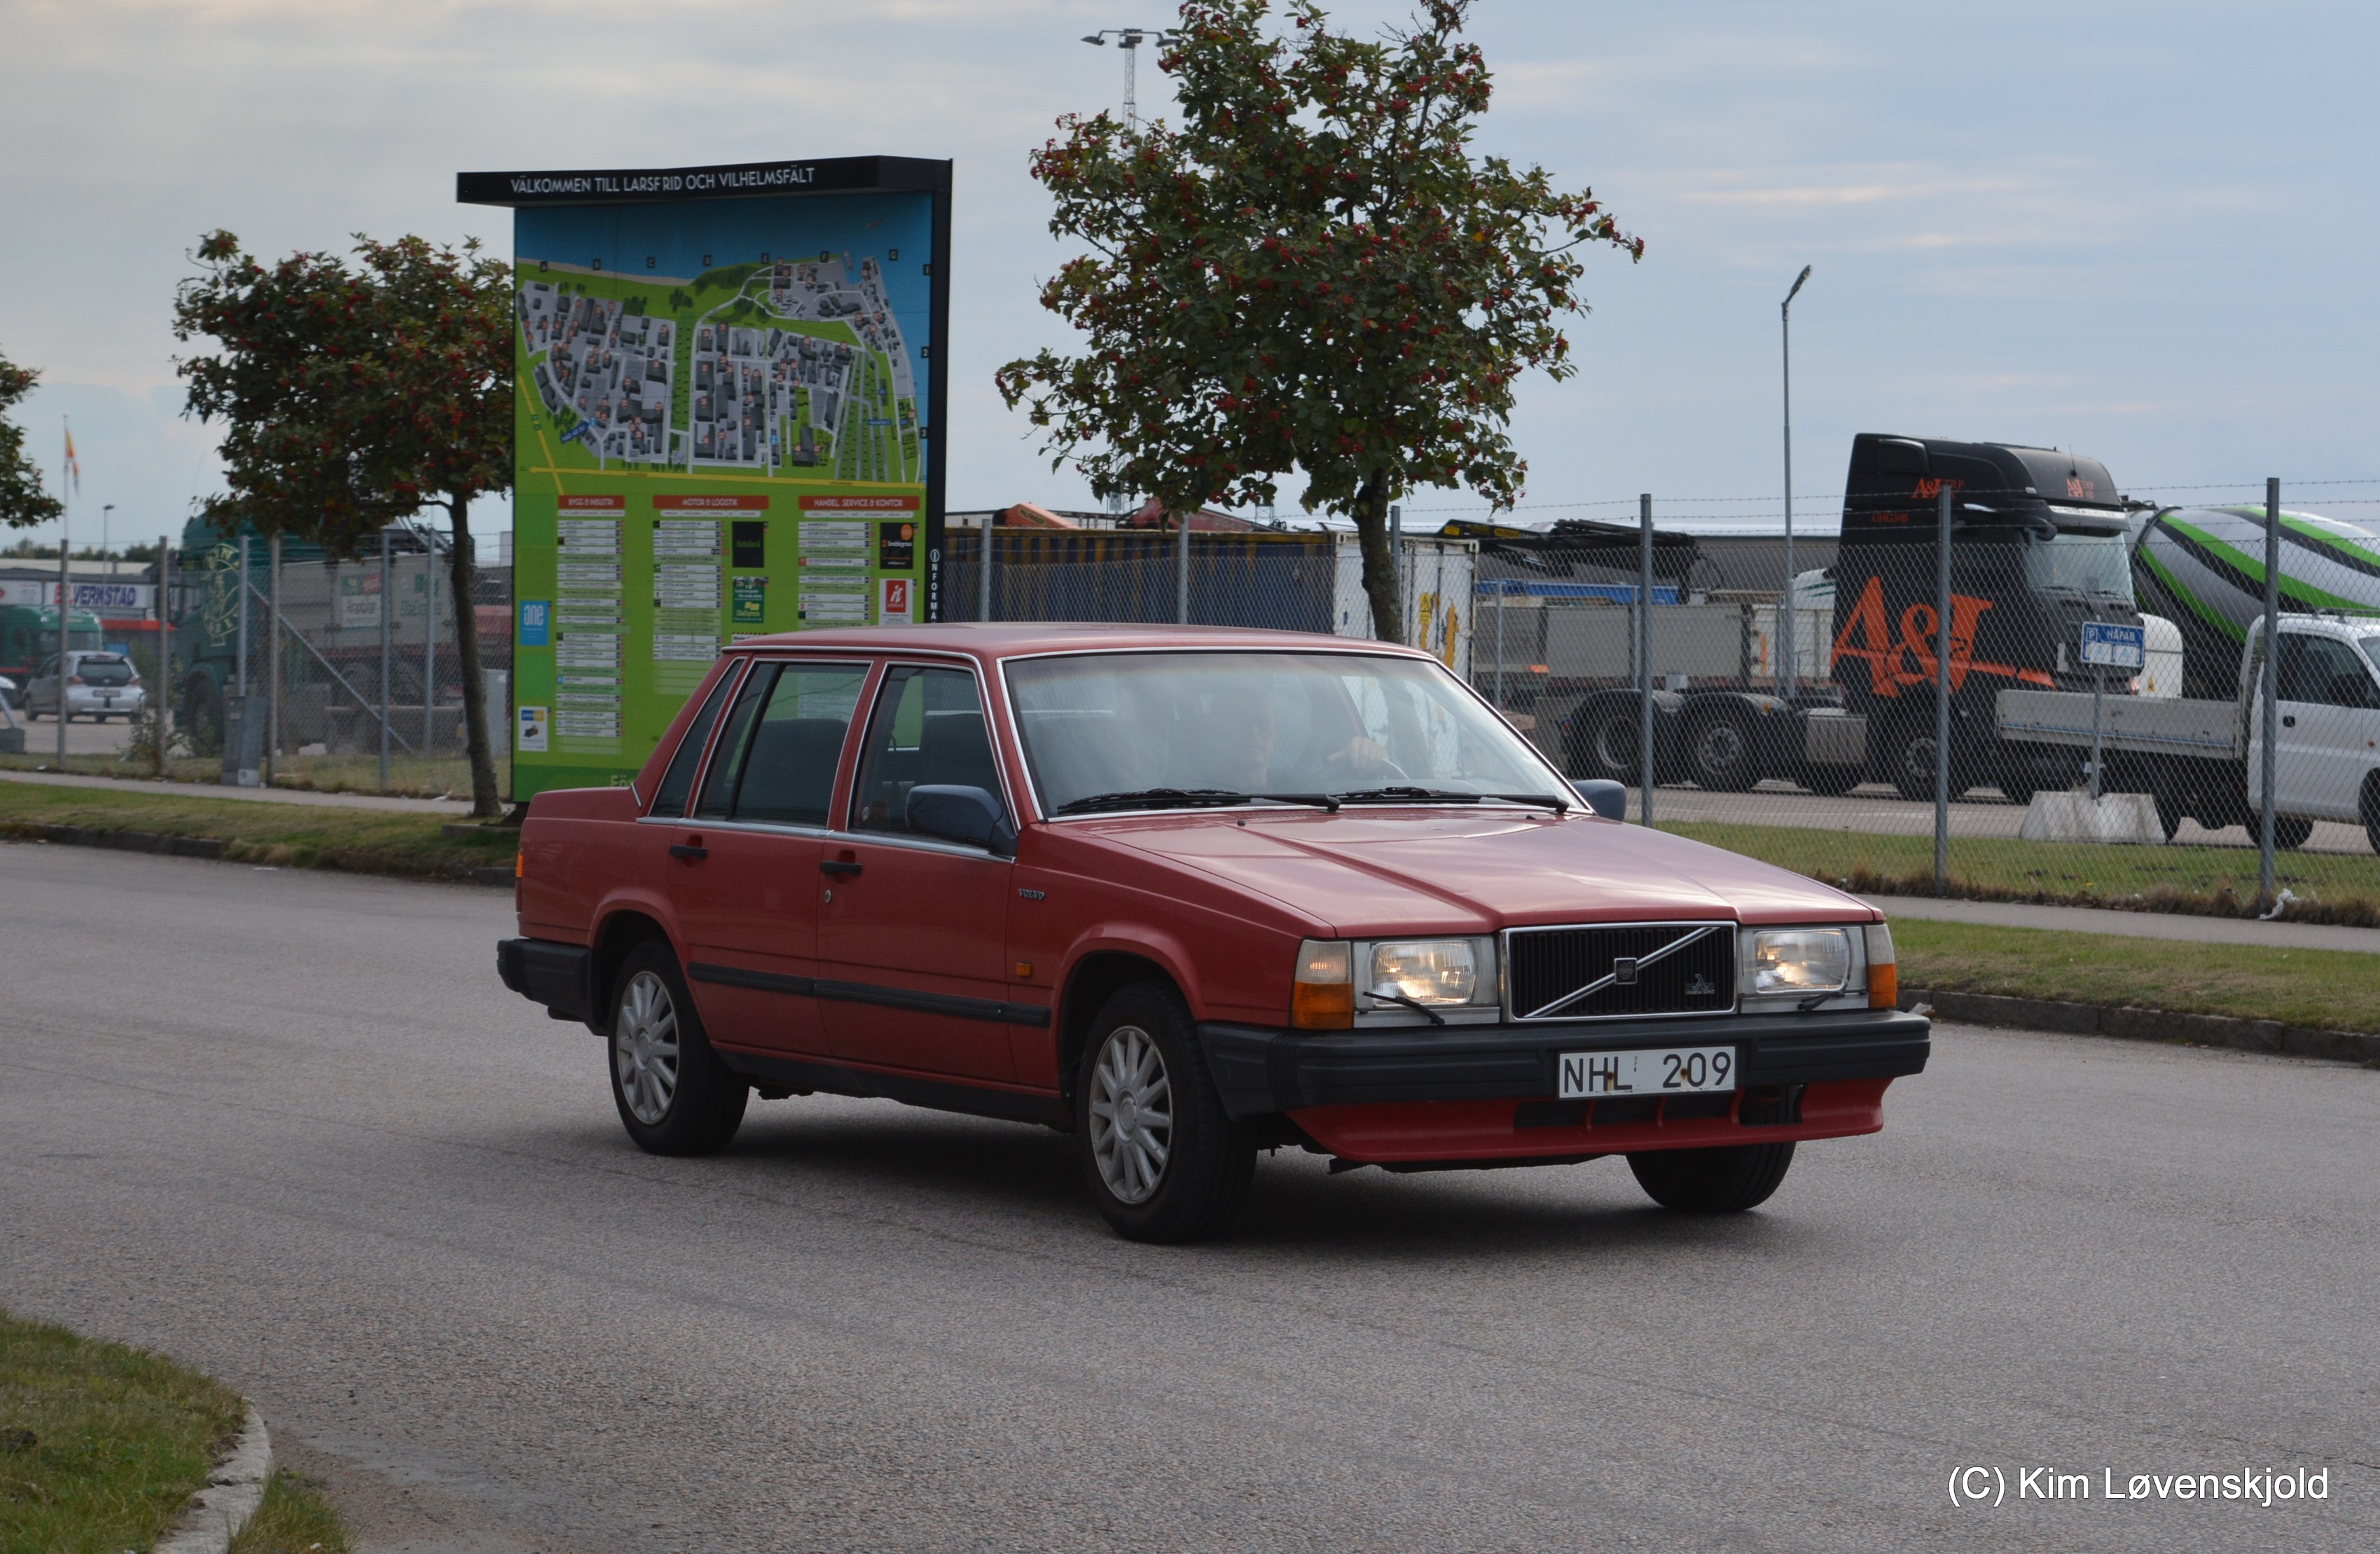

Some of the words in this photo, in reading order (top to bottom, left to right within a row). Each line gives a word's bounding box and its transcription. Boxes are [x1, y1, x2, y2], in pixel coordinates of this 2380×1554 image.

[511, 174, 592, 193] VÄLKOMMEN
[595, 177, 621, 192] TILL
[623, 175, 682, 192] LARSFRID
[685, 174, 715, 190] OCH
[718, 164, 815, 188] VILHELMSFÄLT
[712, 498, 738, 507] LOGISTIK
[1911, 477, 1943, 499] A&J
[929, 549, 941, 623] INFORMA
[1829, 575, 1994, 698] A&J
[1018, 888, 1045, 900] VOLVO
[1564, 1056, 1633, 1093] NHL
[1662, 1051, 1731, 1088] 209
